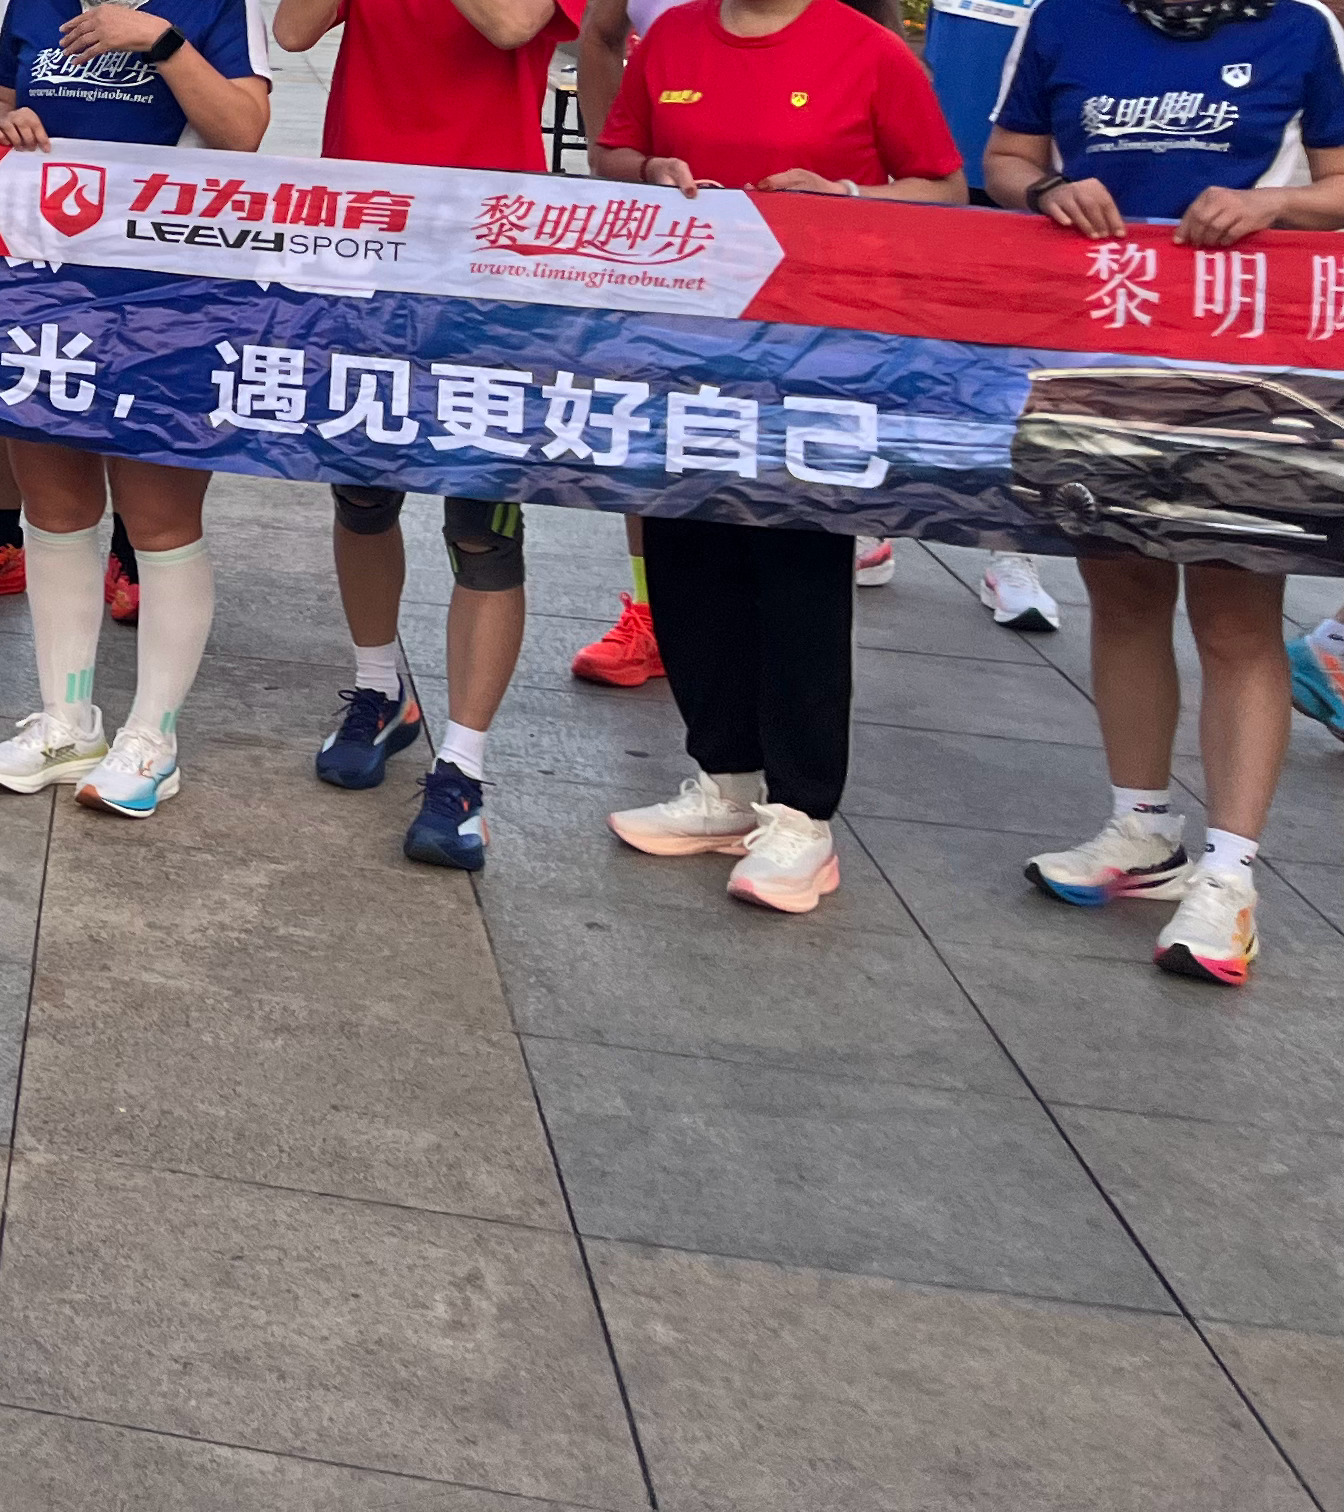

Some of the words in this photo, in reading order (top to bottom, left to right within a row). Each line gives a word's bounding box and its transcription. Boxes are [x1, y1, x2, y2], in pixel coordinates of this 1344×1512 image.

[128, 172, 416, 233] 力为体育
[470, 193, 714, 259] 黎明脚步
[469, 259, 707, 291] www.limingjiaobu.net
